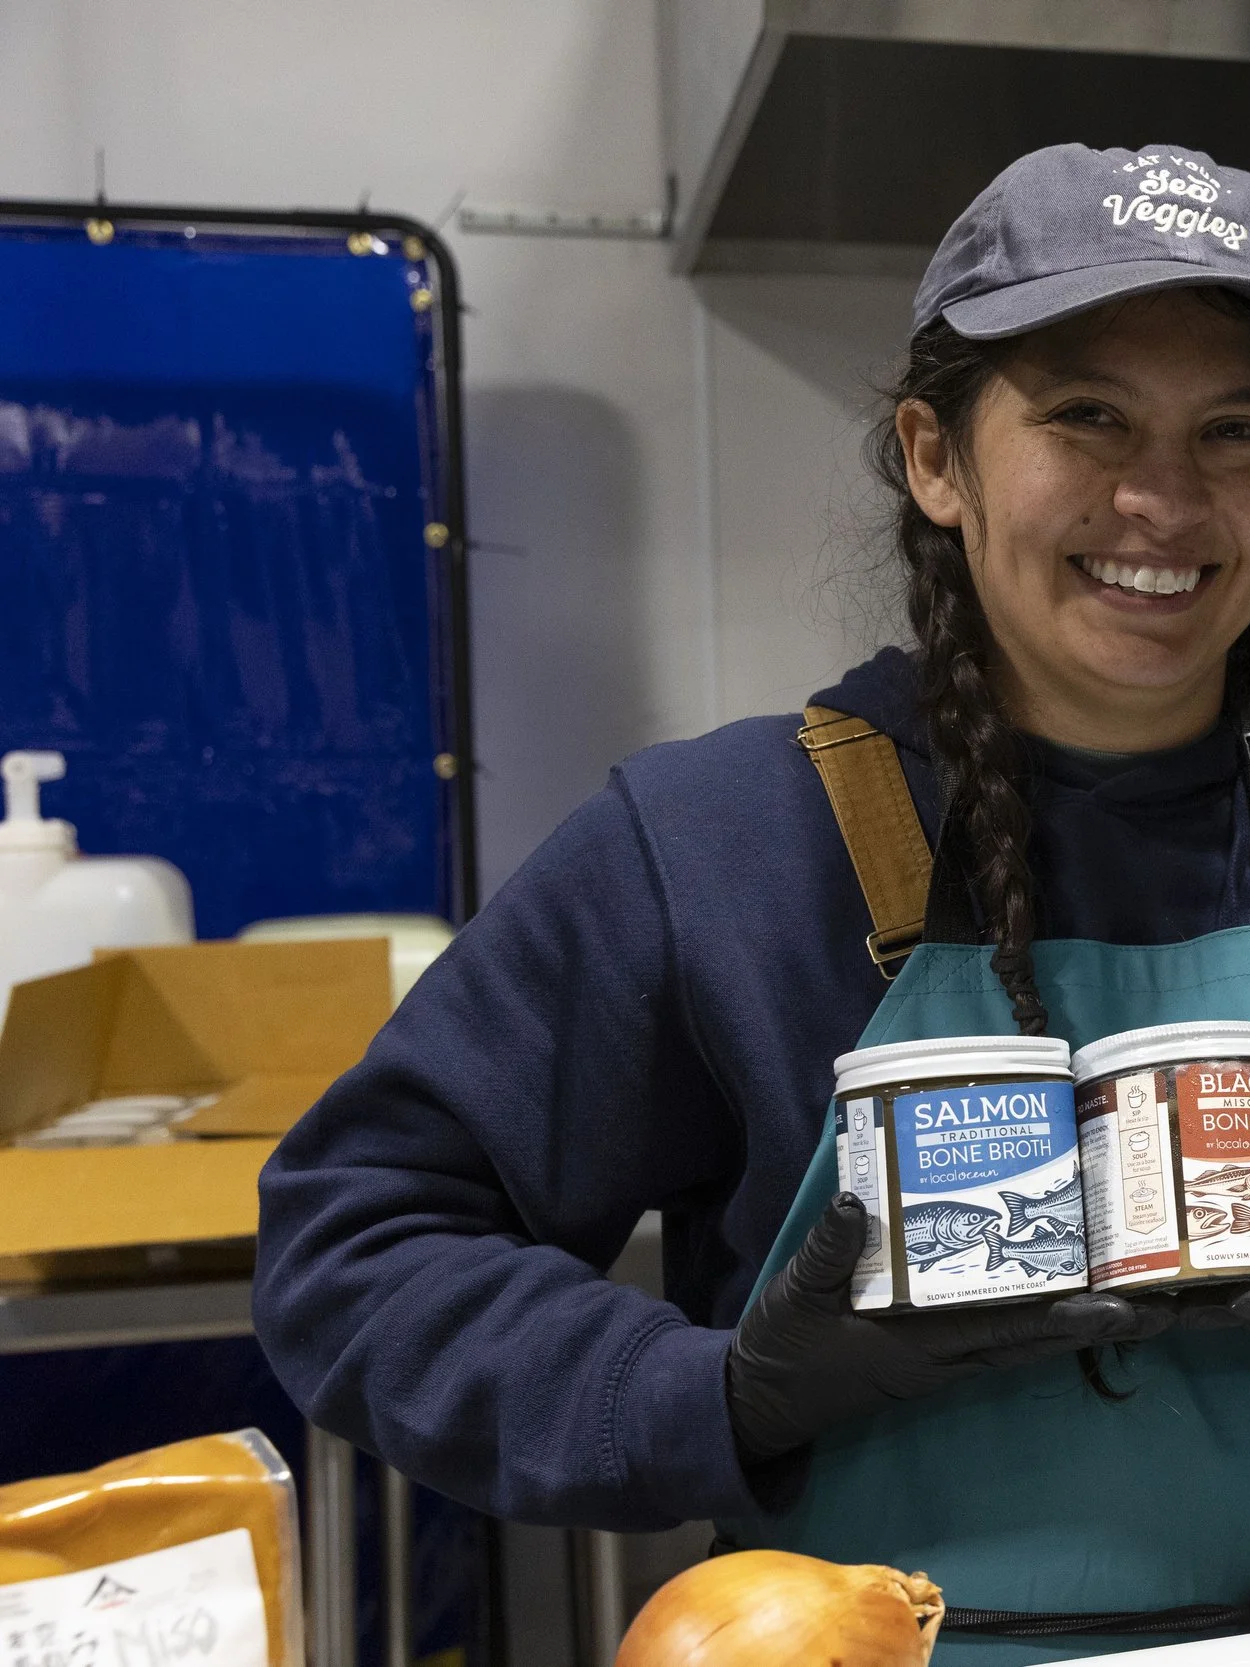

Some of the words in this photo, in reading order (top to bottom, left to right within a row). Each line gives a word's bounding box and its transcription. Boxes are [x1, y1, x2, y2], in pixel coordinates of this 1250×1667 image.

[1122, 155, 1160, 173] EAT
[1139, 169, 1218, 203] Sea
[1103, 194, 1248, 250] Veggies
[914, 1092, 1048, 1129] SALMON
[941, 1125, 1033, 1143] TRADITIONAL
[919, 1145, 983, 1169] BONE
[989, 1138, 1051, 1160] BROTH
[1135, 1204, 1154, 1212] STEAM
[927, 1292, 955, 1301] SLOWLY
[957, 1287, 997, 1298] SIMMERED
[1026, 1281, 1046, 1289] COAST
